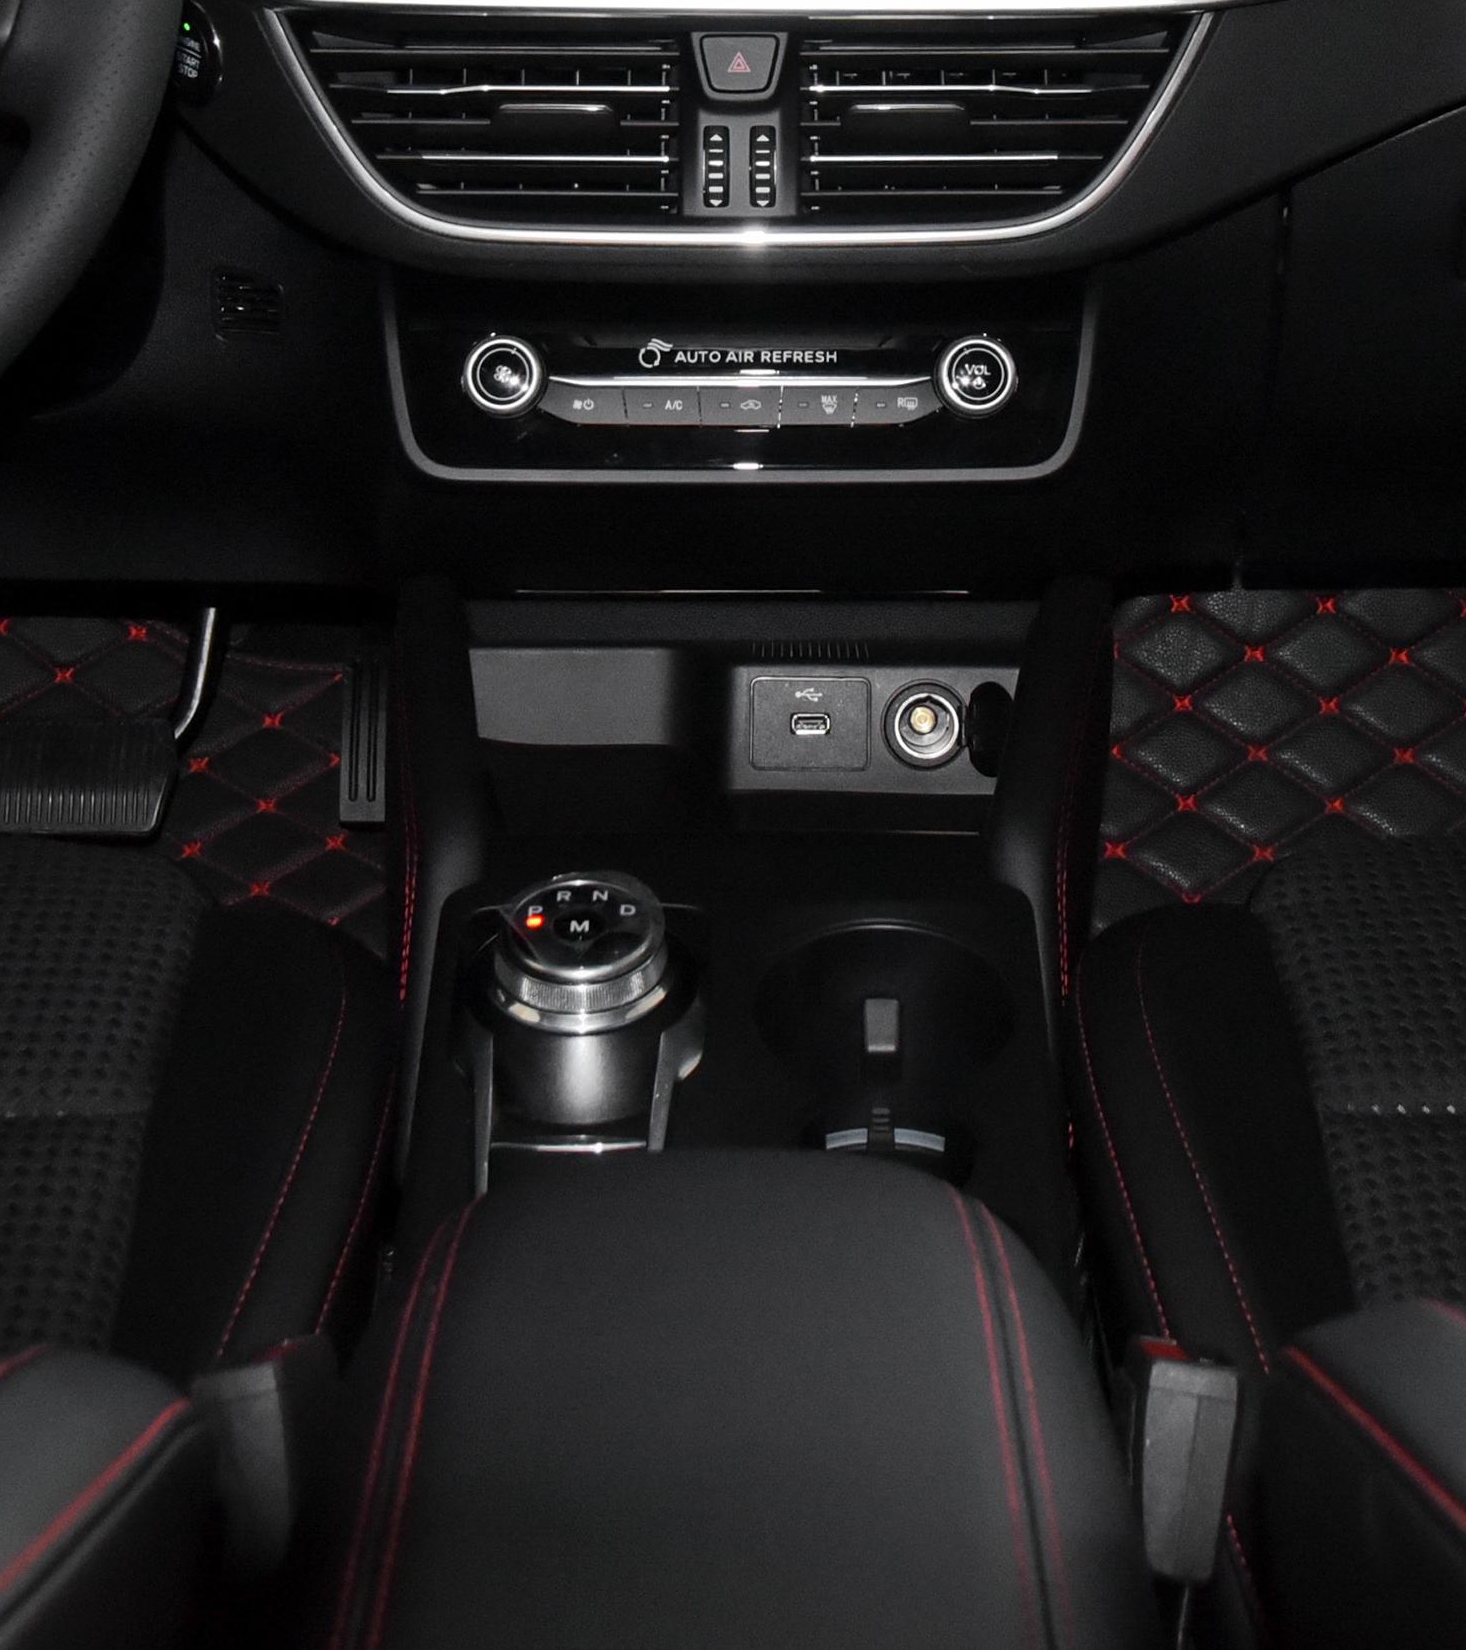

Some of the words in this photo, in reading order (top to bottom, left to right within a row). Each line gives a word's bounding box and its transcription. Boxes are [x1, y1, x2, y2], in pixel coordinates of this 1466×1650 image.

[674, 349, 722, 364] AUTO
[725, 349, 755, 364] AIR
[760, 349, 838, 364] REFRESH
[964, 363, 992, 376] VOL
[664, 398, 684, 411] A/C
[821, 395, 838, 404] MAX
[527, 905, 544, 915] P
[556, 890, 572, 901] R
[592, 890, 609, 901] N
[619, 904, 636, 915] D
[569, 919, 590, 933] M
